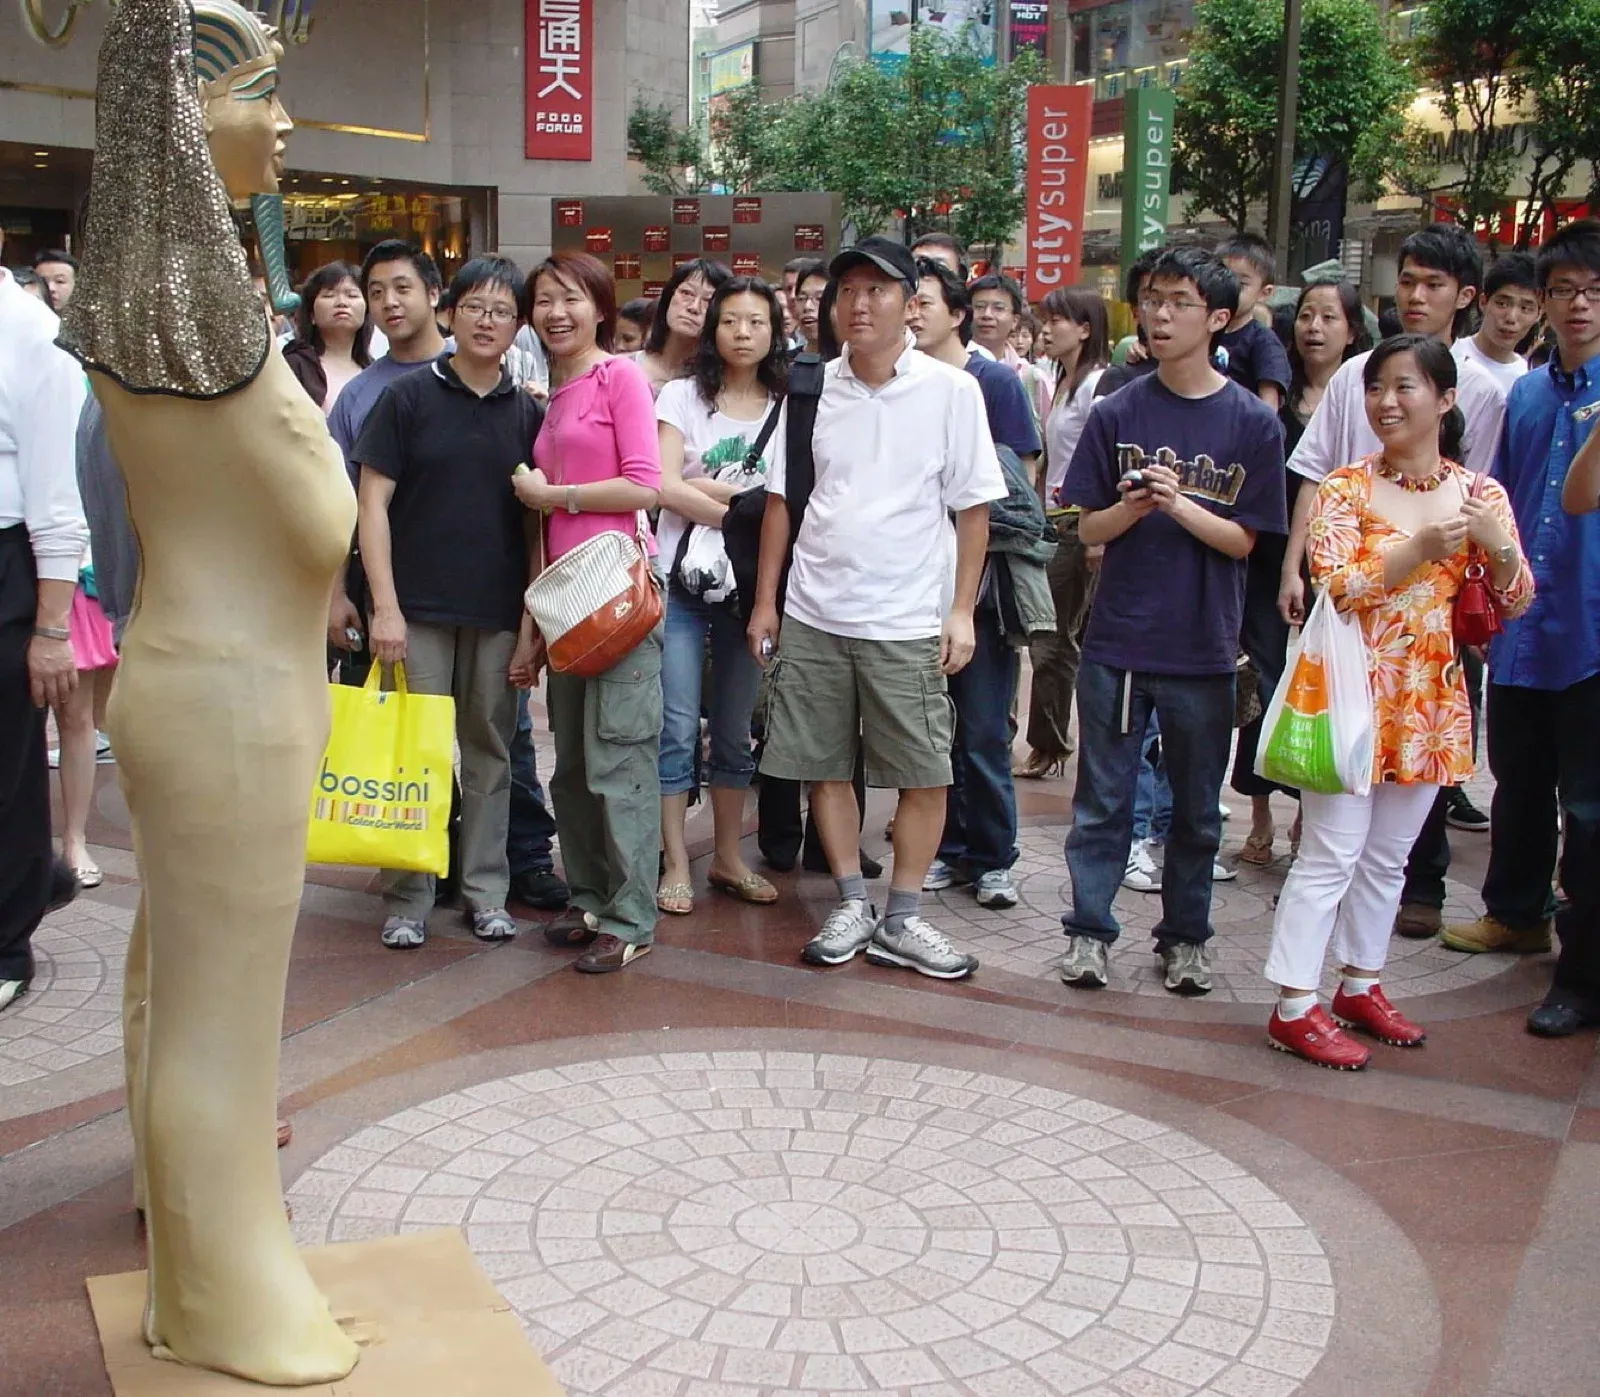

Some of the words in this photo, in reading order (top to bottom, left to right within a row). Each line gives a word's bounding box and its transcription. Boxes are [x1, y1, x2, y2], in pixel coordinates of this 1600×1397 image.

[536, 112, 583, 122] FOOD
[536, 123, 583, 134] FORUM
[1032, 106, 1076, 285] city'super
[1139, 110, 1168, 252] ty'super
[319, 756, 430, 803] bossini
